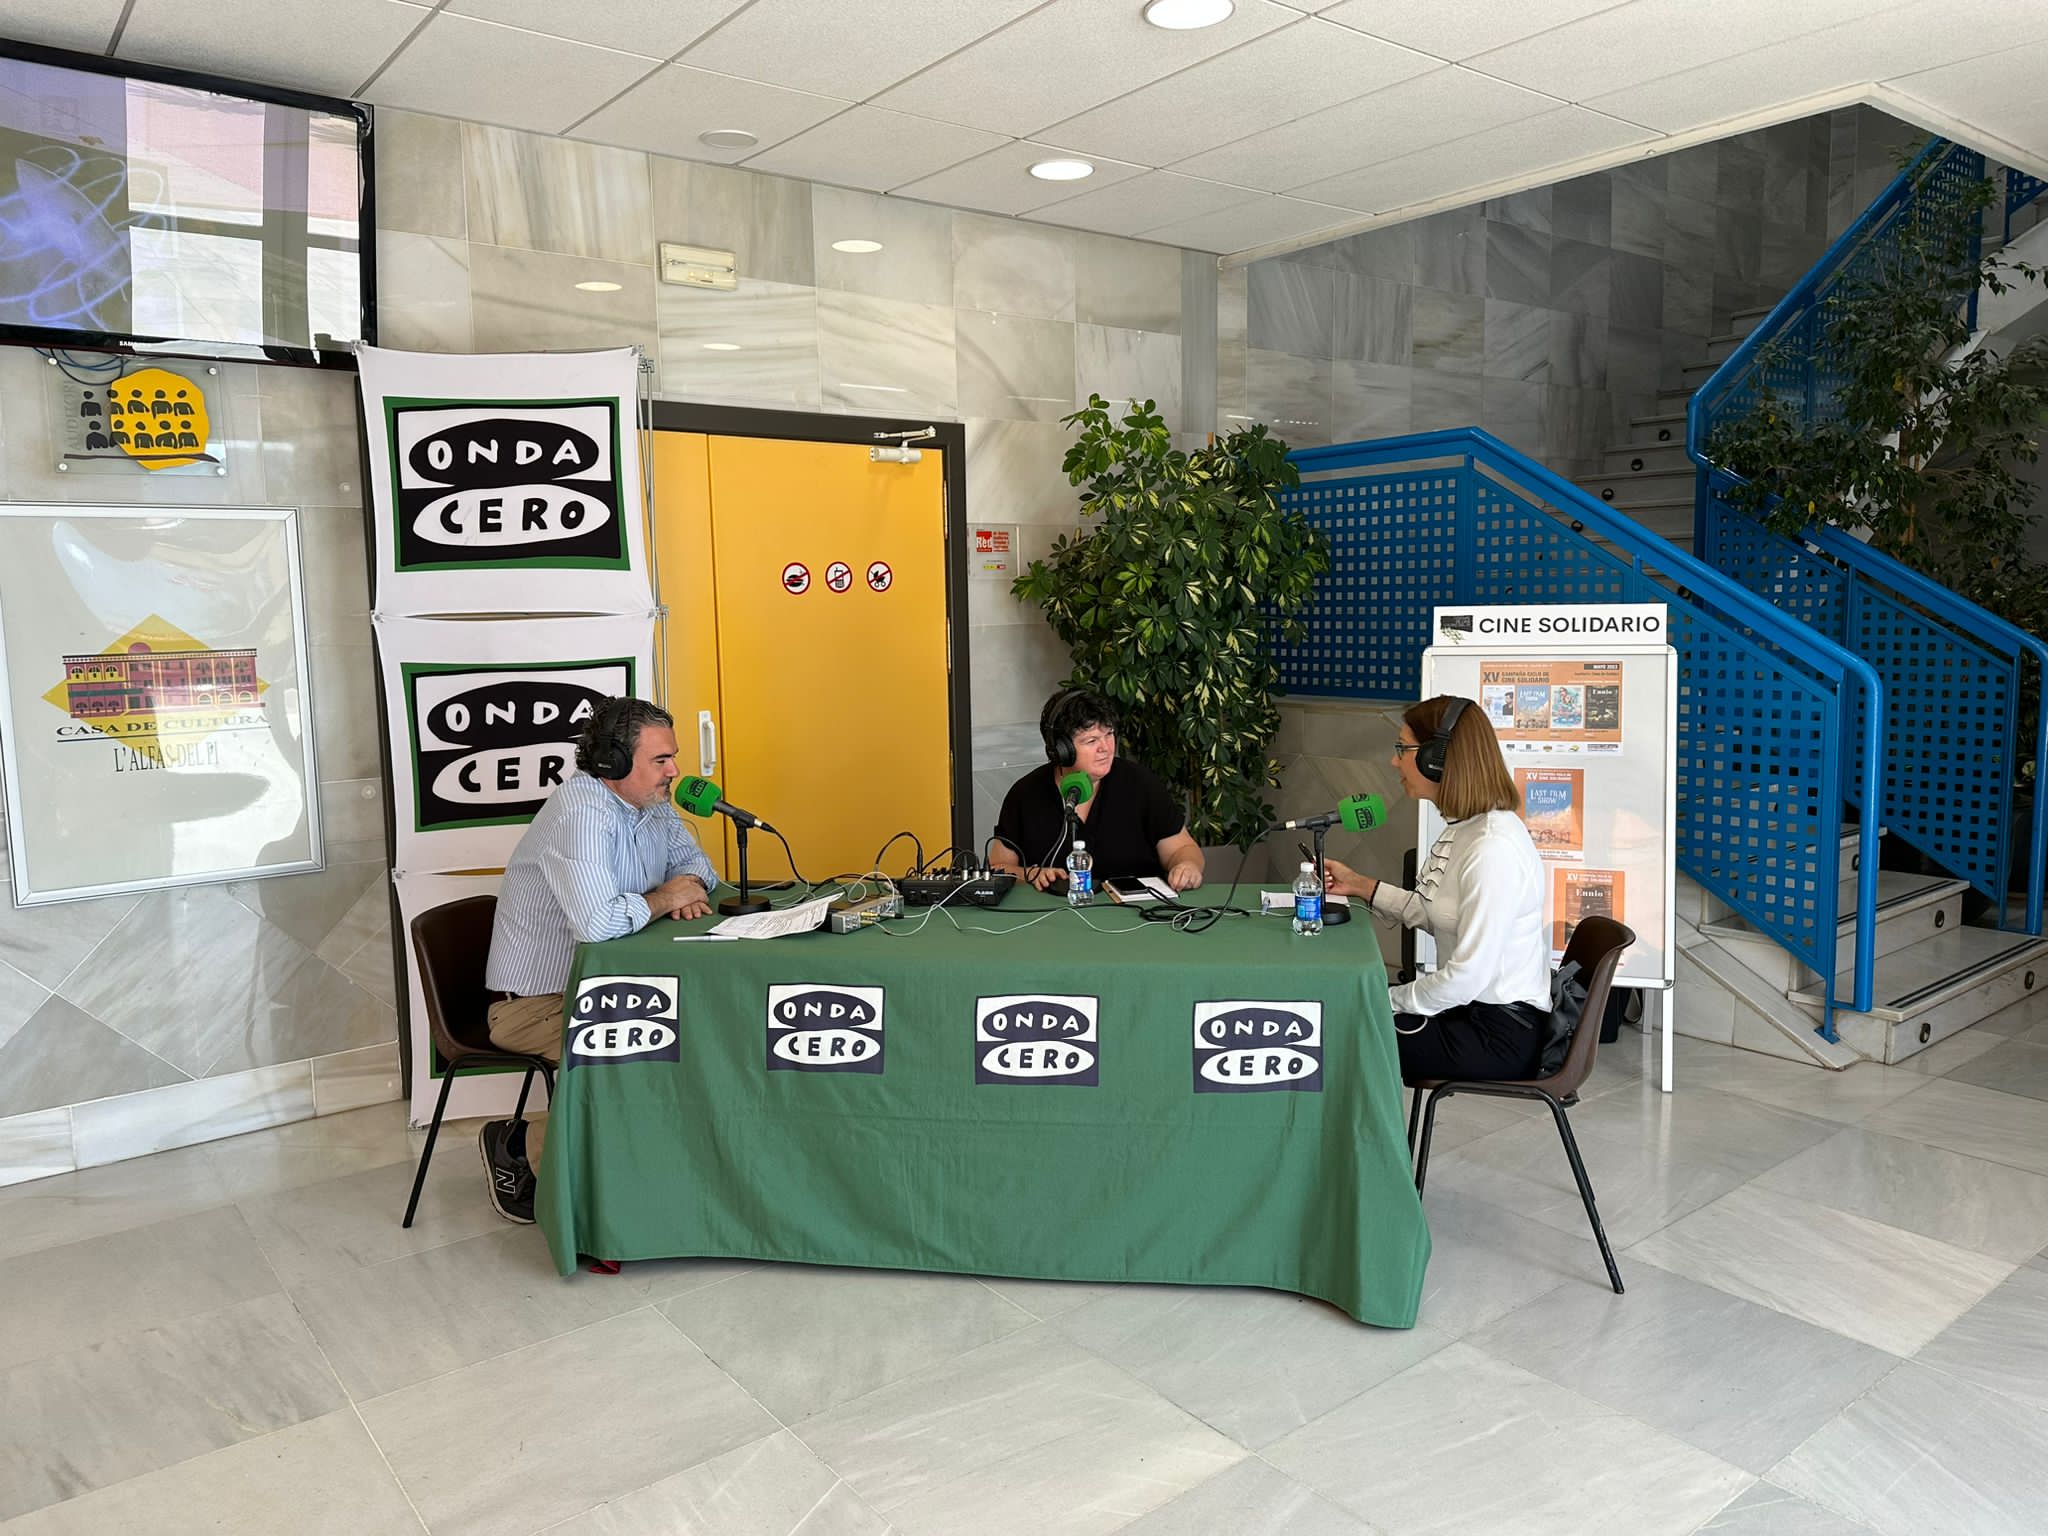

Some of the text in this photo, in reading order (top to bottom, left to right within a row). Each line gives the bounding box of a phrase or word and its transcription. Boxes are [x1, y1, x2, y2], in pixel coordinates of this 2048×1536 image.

[427, 438, 581, 471] ONDA
[440, 497, 585, 534] CERO
[1479, 617, 1532, 633] CINE
[1538, 616, 1660, 633] SOLIDARIO
[1483, 671, 1500, 683] XV
[56, 715, 268, 736] CASA DE CULTURA
[445, 698, 593, 732] ONDA
[458, 755, 565, 793] CER
[579, 993, 663, 1014] ONDA
[783, 1002, 867, 1020] ONDA
[992, 1013, 1080, 1031] ONDA
[1210, 1019, 1303, 1038] ONDA
[583, 1028, 663, 1050] CERO
[788, 1036, 867, 1057] CERO
[997, 1048, 1080, 1069] CERO
[1216, 1055, 1304, 1076] CERO
